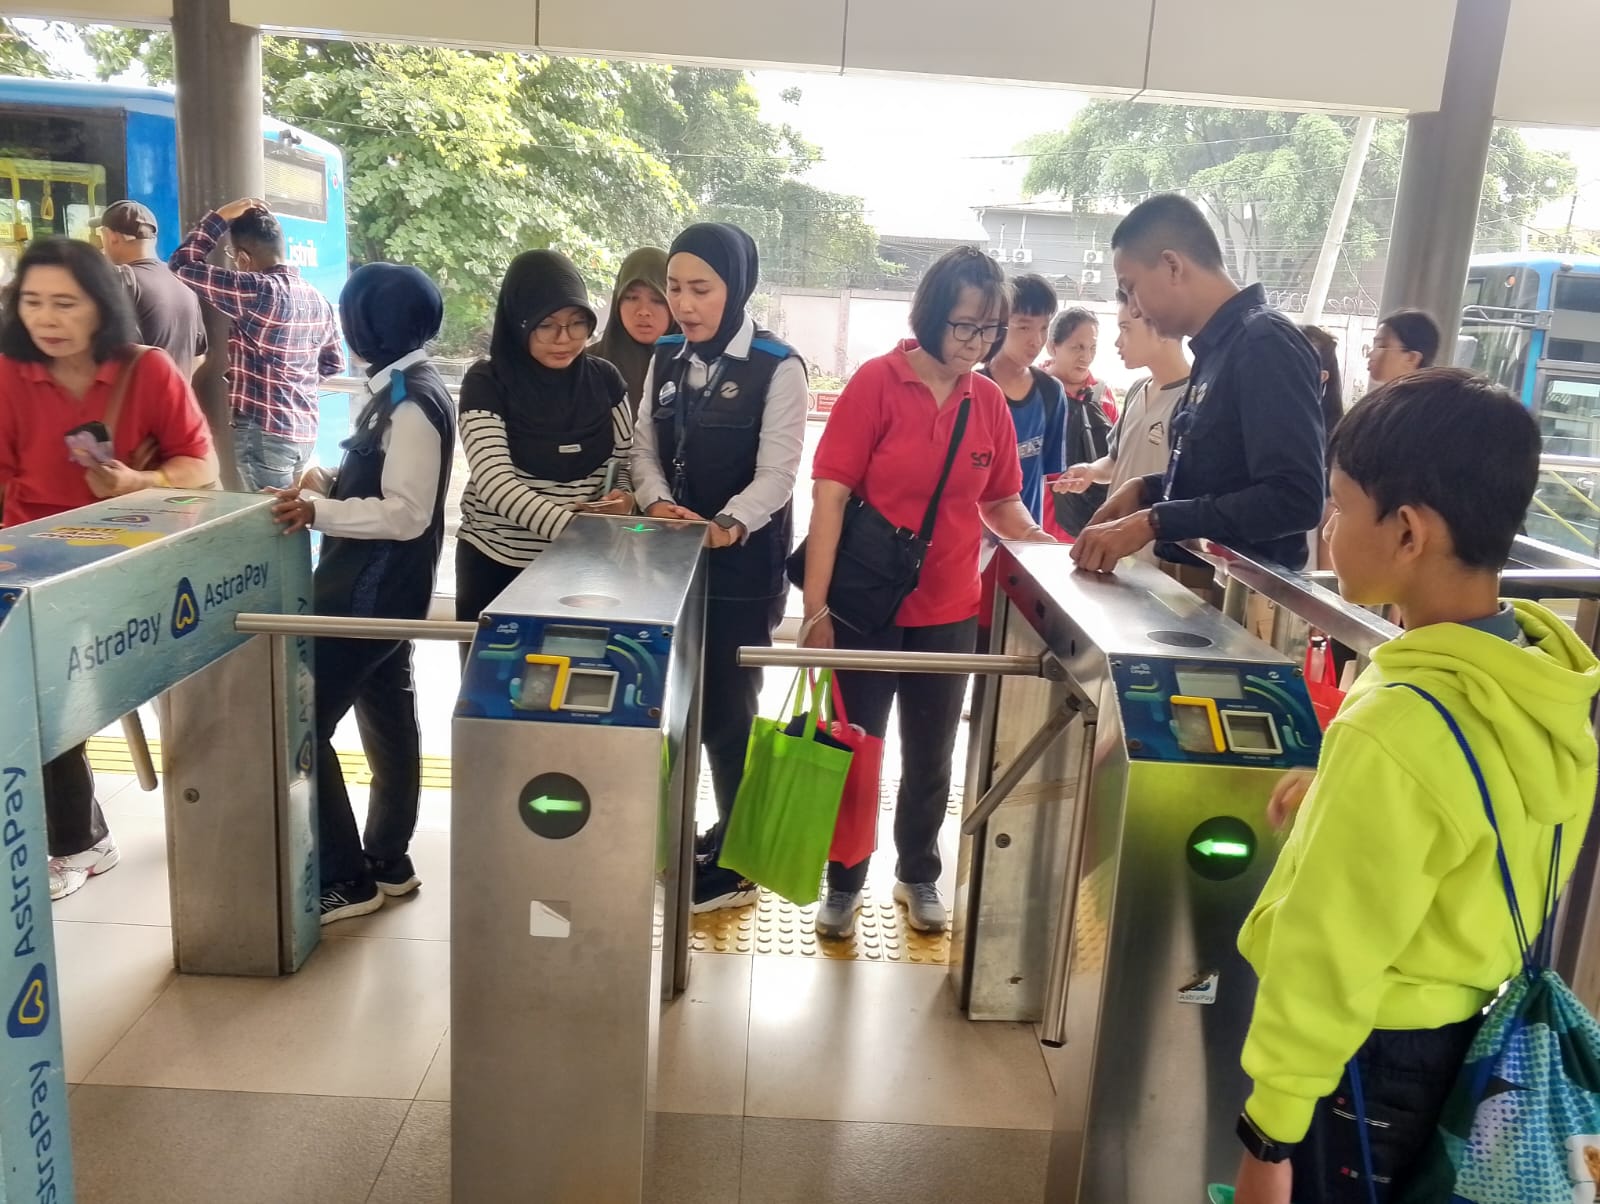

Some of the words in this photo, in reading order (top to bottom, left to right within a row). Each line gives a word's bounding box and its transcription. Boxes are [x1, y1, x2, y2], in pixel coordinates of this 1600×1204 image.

[204, 562, 269, 611] AstraPay
[67, 613, 161, 680] AstraPay
[3, 766, 36, 957] AstraPay
[29, 1060, 57, 1204] straPay
